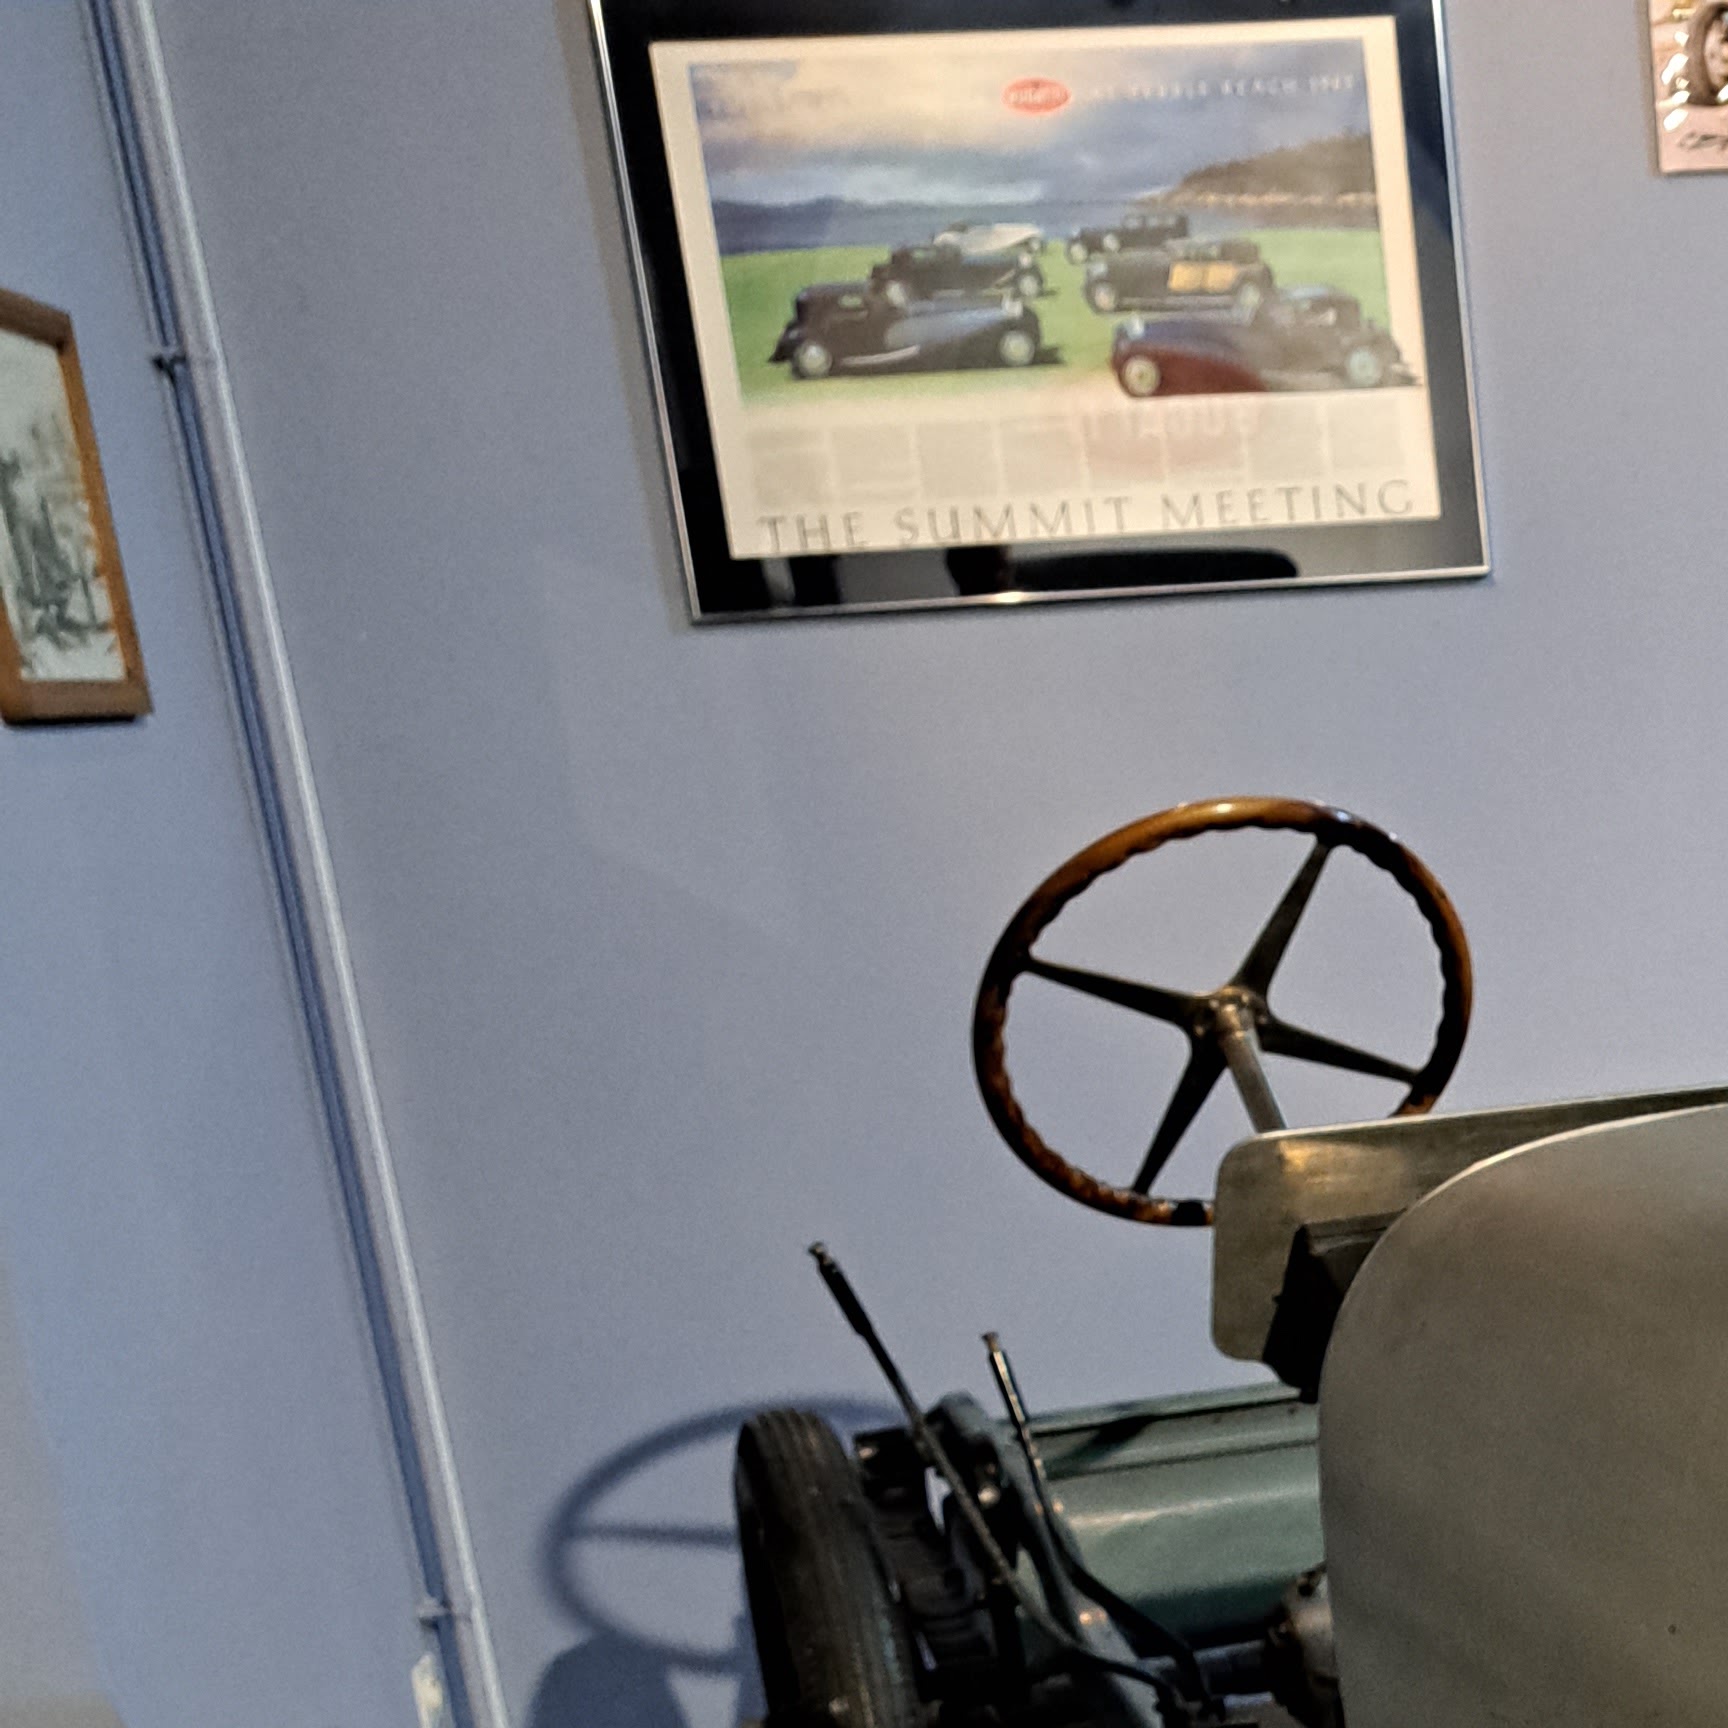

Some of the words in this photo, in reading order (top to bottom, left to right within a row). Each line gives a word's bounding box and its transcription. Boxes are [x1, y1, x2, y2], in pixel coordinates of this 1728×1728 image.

[757, 511, 866, 551] THE
[894, 496, 1132, 545] SUMMIT
[1160, 480, 1414, 529] MEETING
